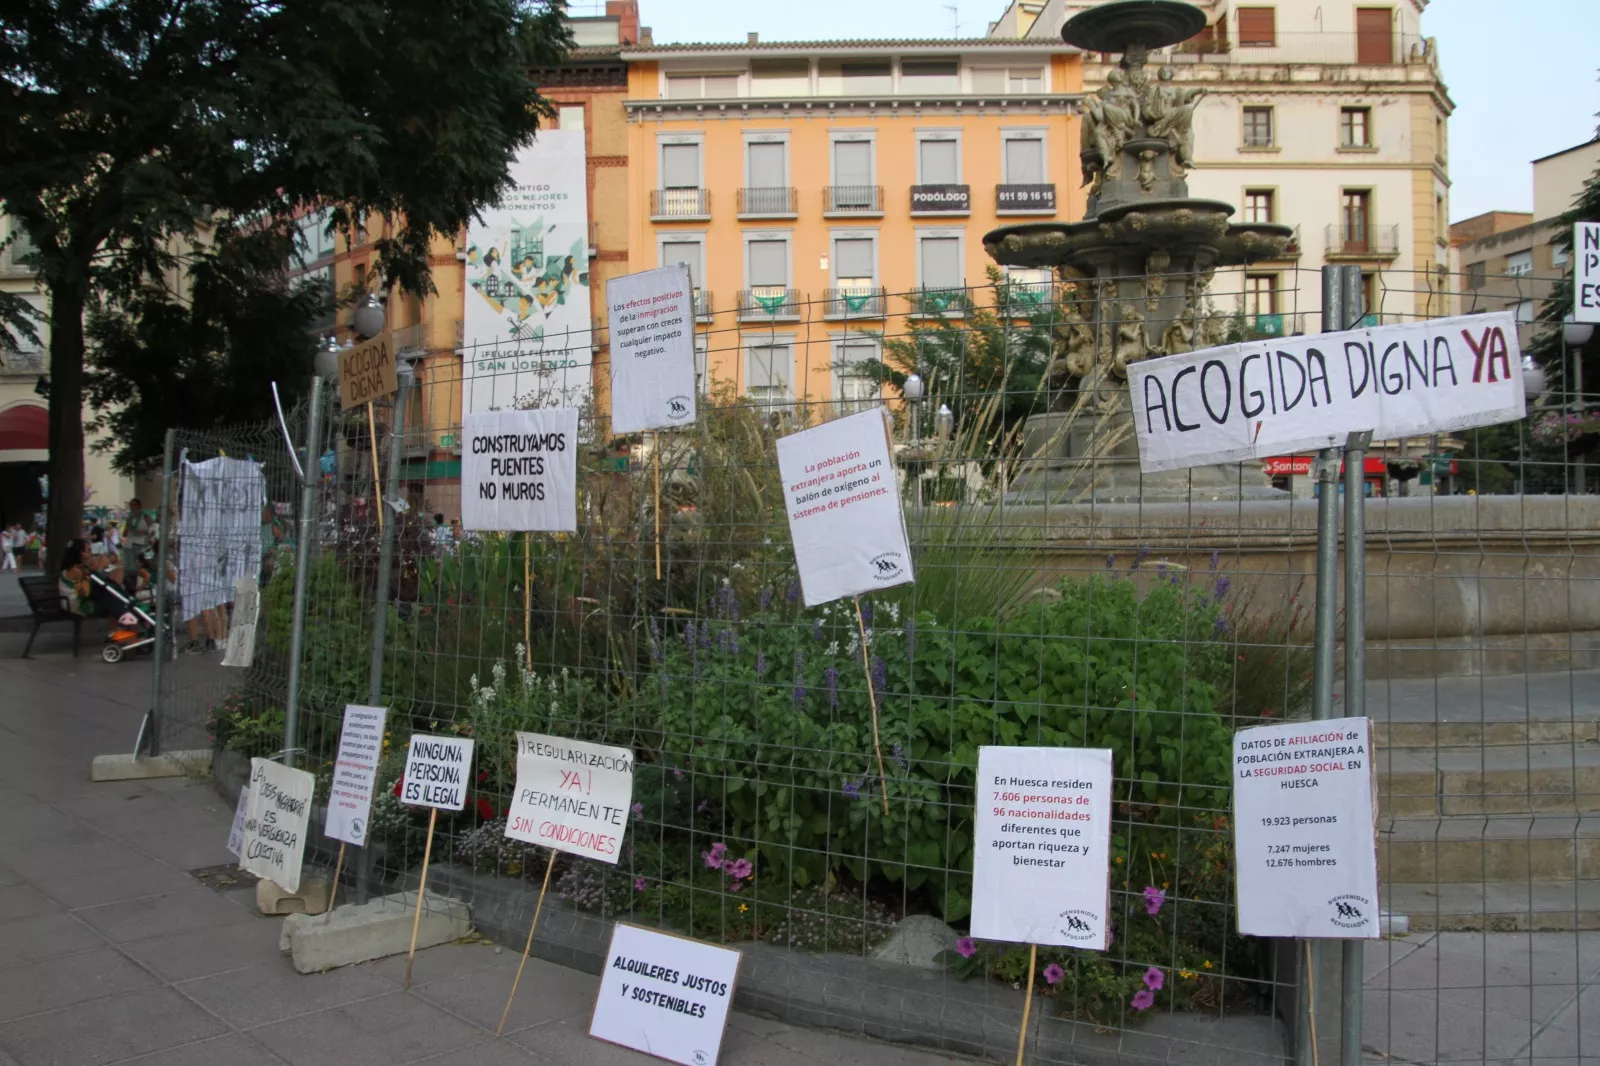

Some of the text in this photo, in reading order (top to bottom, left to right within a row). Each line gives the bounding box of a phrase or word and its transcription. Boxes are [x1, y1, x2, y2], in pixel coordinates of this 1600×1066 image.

[522, 193, 568, 201] MEJORES
[913, 192, 967, 201] PODÓLOGO
[999, 191, 1015, 201] 611
[1017, 191, 1028, 201] 59
[1030, 191, 1041, 200] 16
[613, 290, 683, 312] Los efectos positivos
[619, 304, 678, 323] de la inmigración
[618, 317, 683, 337] superan con creces
[620, 330, 682, 349] cualquier impacto
[343, 341, 389, 380] ACOGIDA
[634, 346, 666, 359] negativo.
[478, 361, 506, 371] SAN
[350, 370, 384, 401] DIGNA
[1144, 327, 1511, 433] ACOGIDA DIGNA YA
[472, 433, 565, 454] CONSTRUYAMOS
[491, 457, 544, 476] PUENTES
[804, 450, 860, 474] La población
[790, 458, 882, 493] extranjera aporta un
[479, 482, 545, 500] NO MUROS
[795, 473, 880, 505] balón de oxígeno al
[793, 487, 889, 520] sistema de pensiones.
[1241, 731, 1359, 750] DATOS DE AFILIACIÓN de
[413, 741, 462, 763] NINGUNA
[1237, 745, 1364, 765] POBLACIÓN EXTRANJERA A
[253, 766, 264, 783] LA
[409, 761, 460, 785] PERSONA
[1240, 761, 1361, 778] LA SEGURIDAD SOCIAL EN
[559, 769, 591, 796] YA!
[994, 776, 1093, 790] En Huesca residen
[1281, 778, 1319, 789] HUESCA
[406, 782, 461, 807] ES ILEGAL
[993, 792, 1089, 806] 7.606 personas de
[264, 810, 277, 824] ES
[520, 789, 623, 826] PERMANENTE
[993, 807, 1091, 821] 96 nacionalidades
[1261, 815, 1337, 827] 19.923 personas
[512, 816, 616, 855] SIN CONDICIONES
[1001, 823, 1081, 839] diferentes que
[992, 840, 1090, 856] aportan riqueza y
[1267, 843, 1330, 855] 7.247 mujeres
[1013, 855, 1066, 868] bienestar
[1265, 857, 1337, 867] 12.676 hombres
[613, 955, 727, 997] ALQUILERES JUSTOS
[621, 983, 707, 1019] Y SOSTENIBLES
